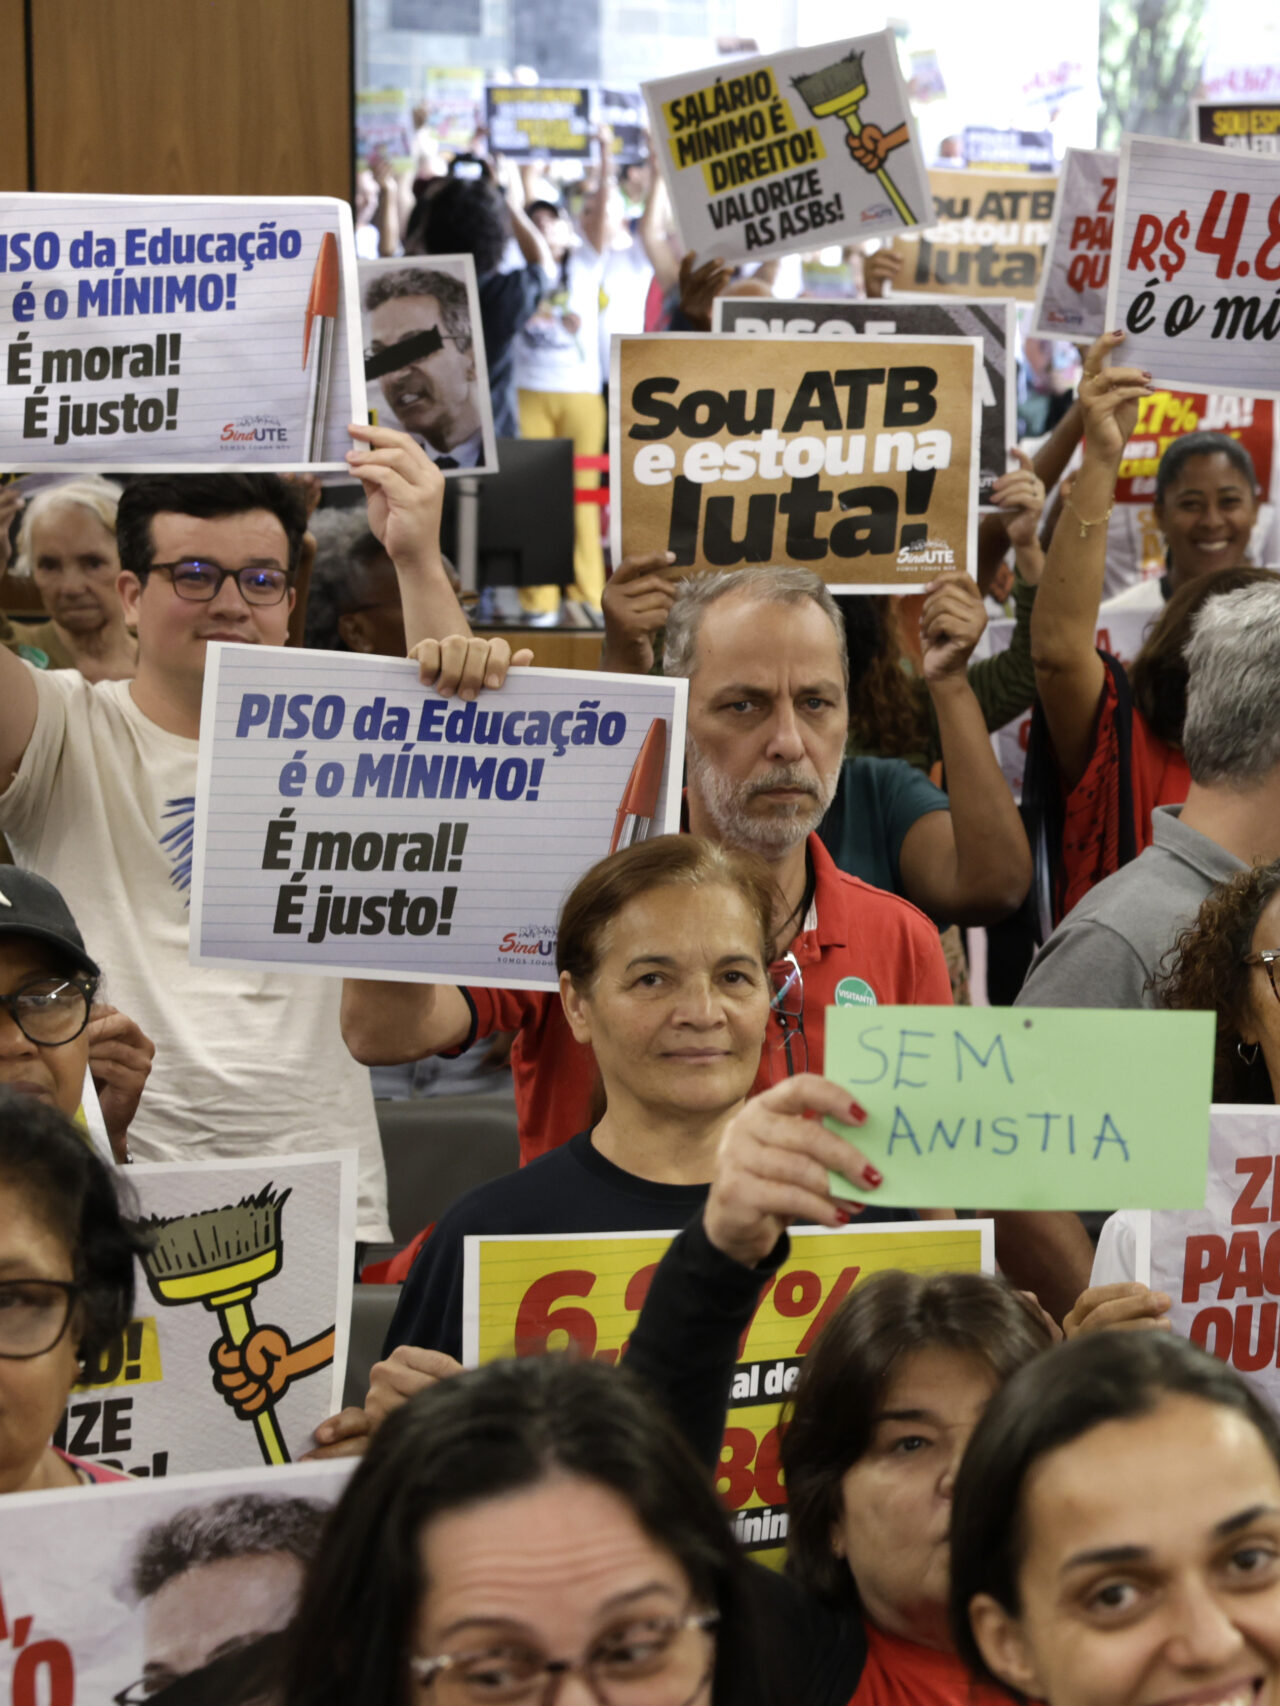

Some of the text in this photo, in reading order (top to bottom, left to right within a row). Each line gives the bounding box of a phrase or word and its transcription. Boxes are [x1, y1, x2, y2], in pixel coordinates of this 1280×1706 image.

[771, 101, 787, 134] É
[1213, 111, 1248, 135] SOU
[711, 130, 817, 191] DIREITO!
[708, 169, 823, 229] VALORIZE
[745, 193, 845, 250] AS ASBs!
[932, 191, 1055, 220] ou ATB
[0, 222, 301, 273] ISO da Educação
[1067, 254, 1110, 293] QU
[12, 268, 236, 322] é o MÍNIMO!
[1126, 278, 1160, 334] é
[1164, 295, 1205, 337] o
[7, 331, 181, 385] É moral!
[23, 387, 179, 444] É justo!
[221, 423, 288, 441] SindUTE
[628, 377, 775, 441] Sou
[782, 366, 938, 433] ATB
[633, 429, 952, 486] e estou na
[667, 469, 936, 566] luta!
[896, 547, 955, 564] SindUTE
[236, 693, 626, 757] PISO da Educação
[279, 743, 546, 801] é o MÍNIMO!
[261, 807, 469, 872] É moral!
[273, 872, 458, 943] É justo!
[499, 933, 557, 956] SindU
[850, 1025, 1014, 1090] SEM
[887, 1106, 1130, 1162] ANISTIA
